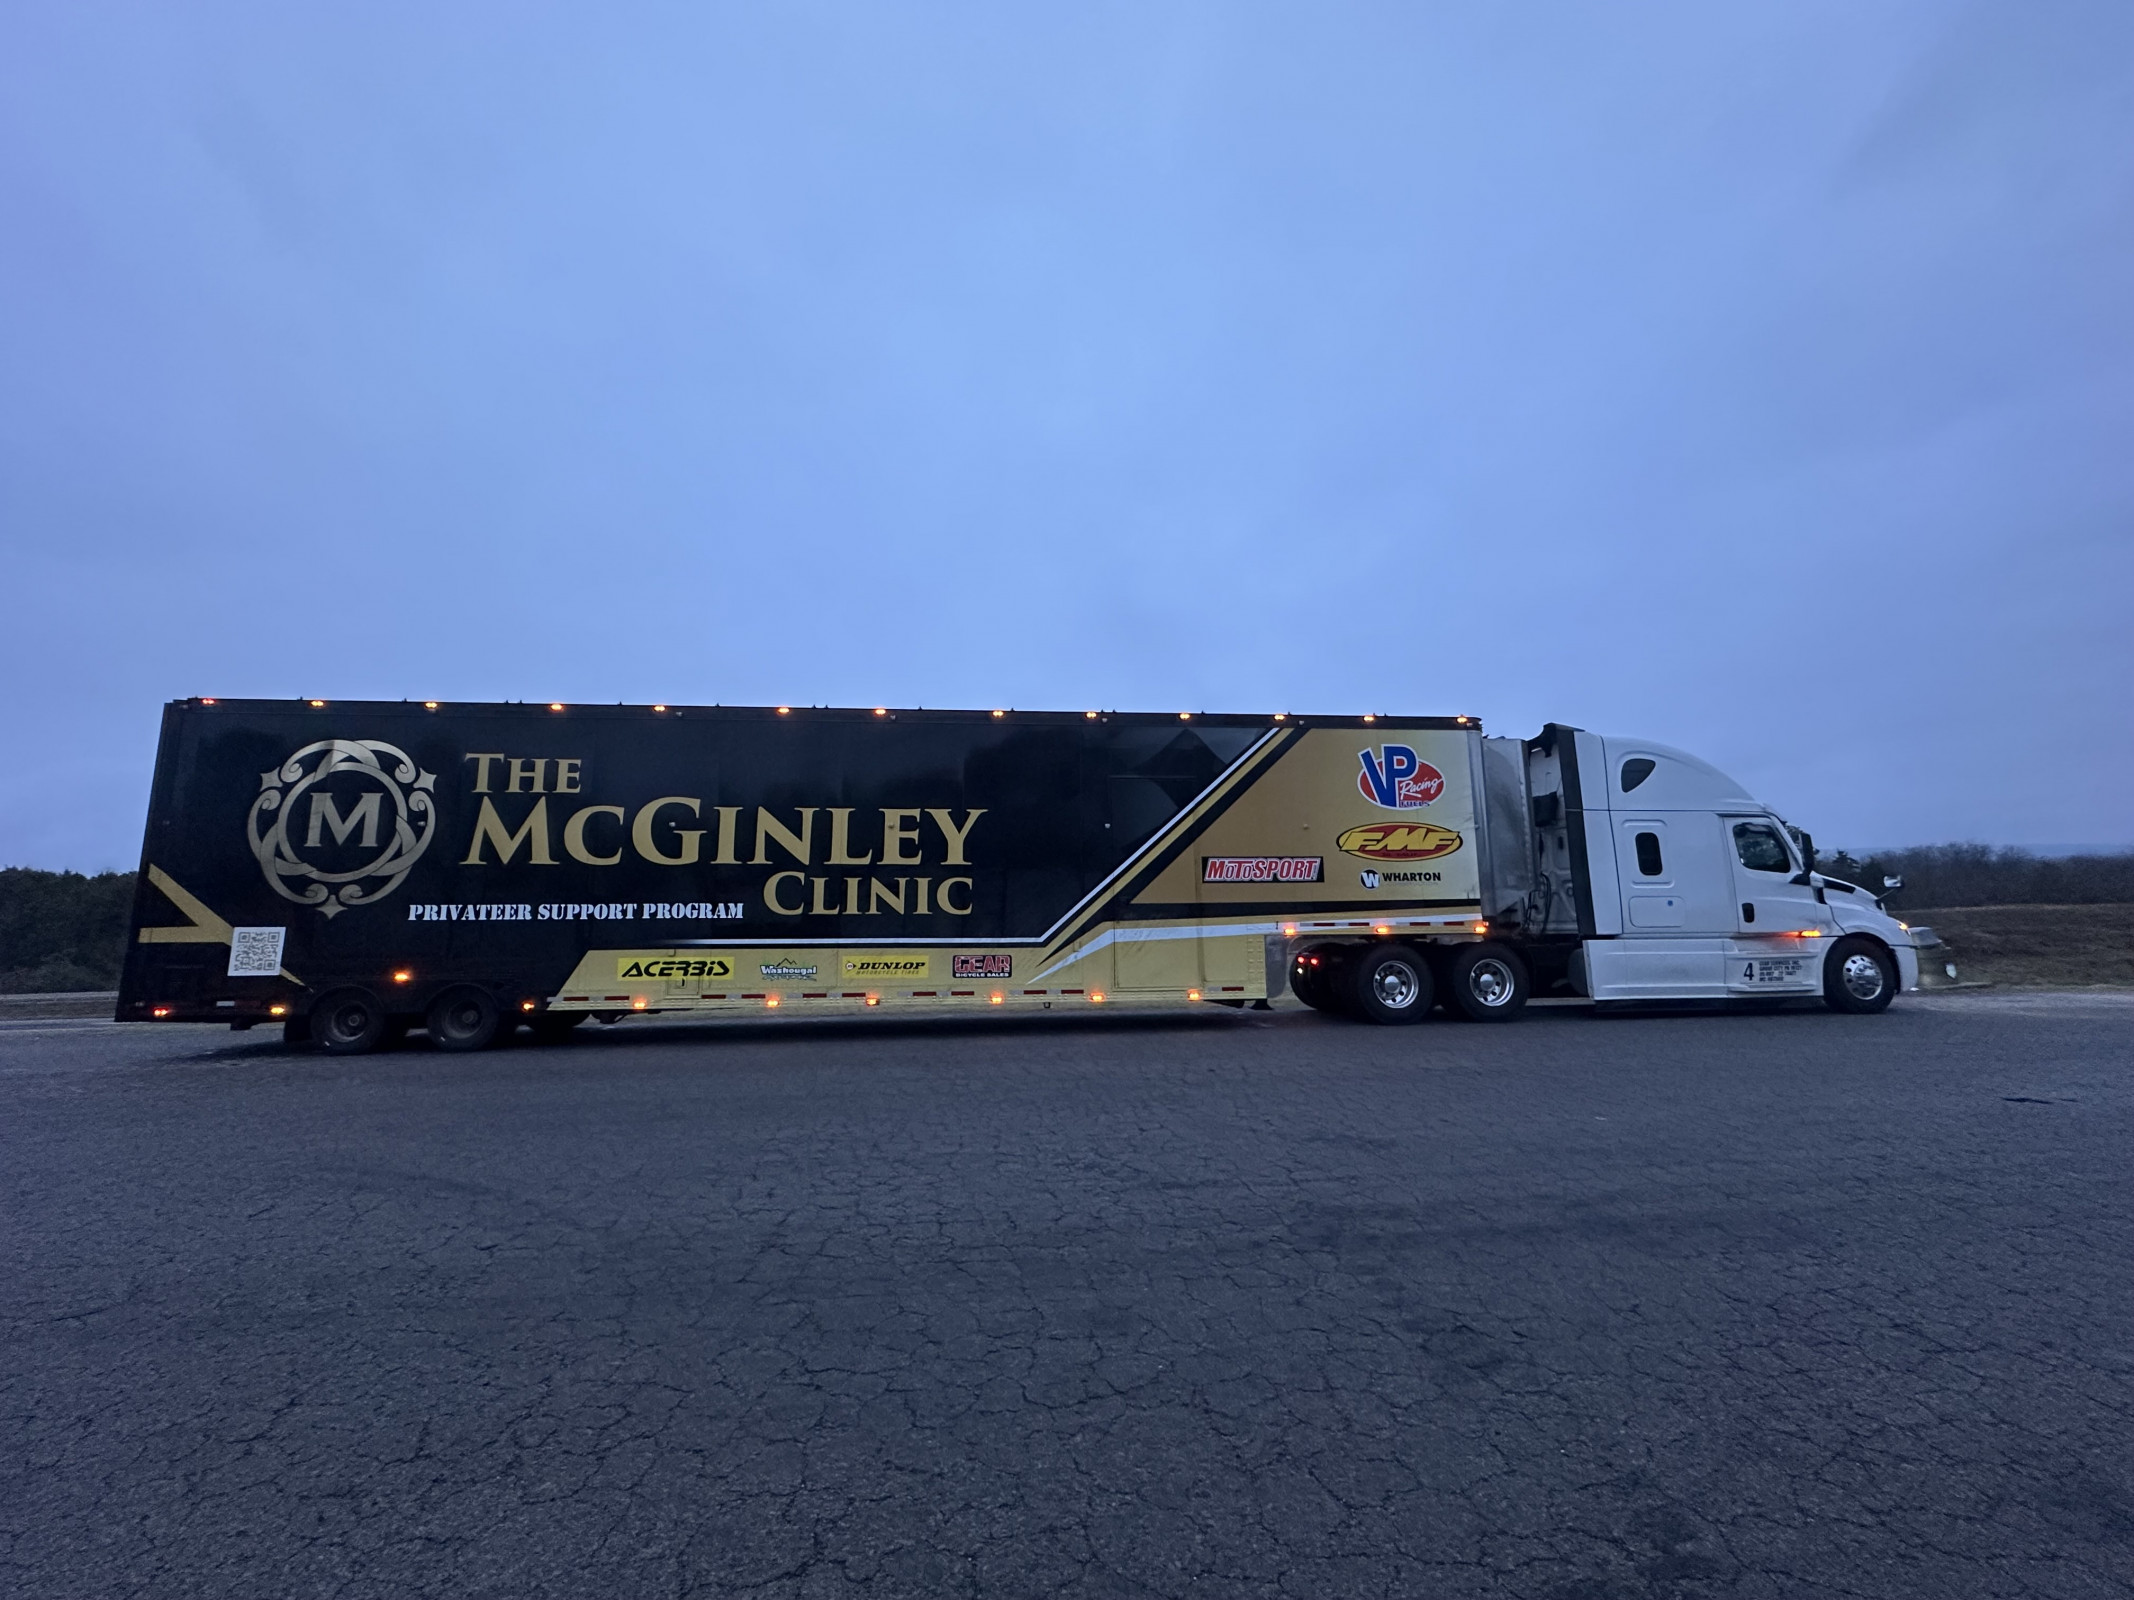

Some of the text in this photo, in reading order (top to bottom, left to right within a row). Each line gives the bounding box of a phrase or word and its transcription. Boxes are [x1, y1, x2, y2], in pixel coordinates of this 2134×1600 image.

[465, 753, 582, 794] THE
[1358, 744, 1418, 808] VP
[1400, 777, 1443, 800] Racing
[304, 792, 384, 848] M
[1340, 828, 1460, 851] FMF
[1382, 872, 1442, 882] WHARTON
[763, 871, 974, 916] CLINIC
[407, 902, 744, 921] PRIVATEER SUPPORT PROGRAM
[621, 961, 730, 978] ACERBIS
[760, 965, 818, 976] Washougal
[858, 961, 926, 970] DUNLOP
[954, 956, 1011, 973] GEAR
[1743, 962, 1755, 981] 4
